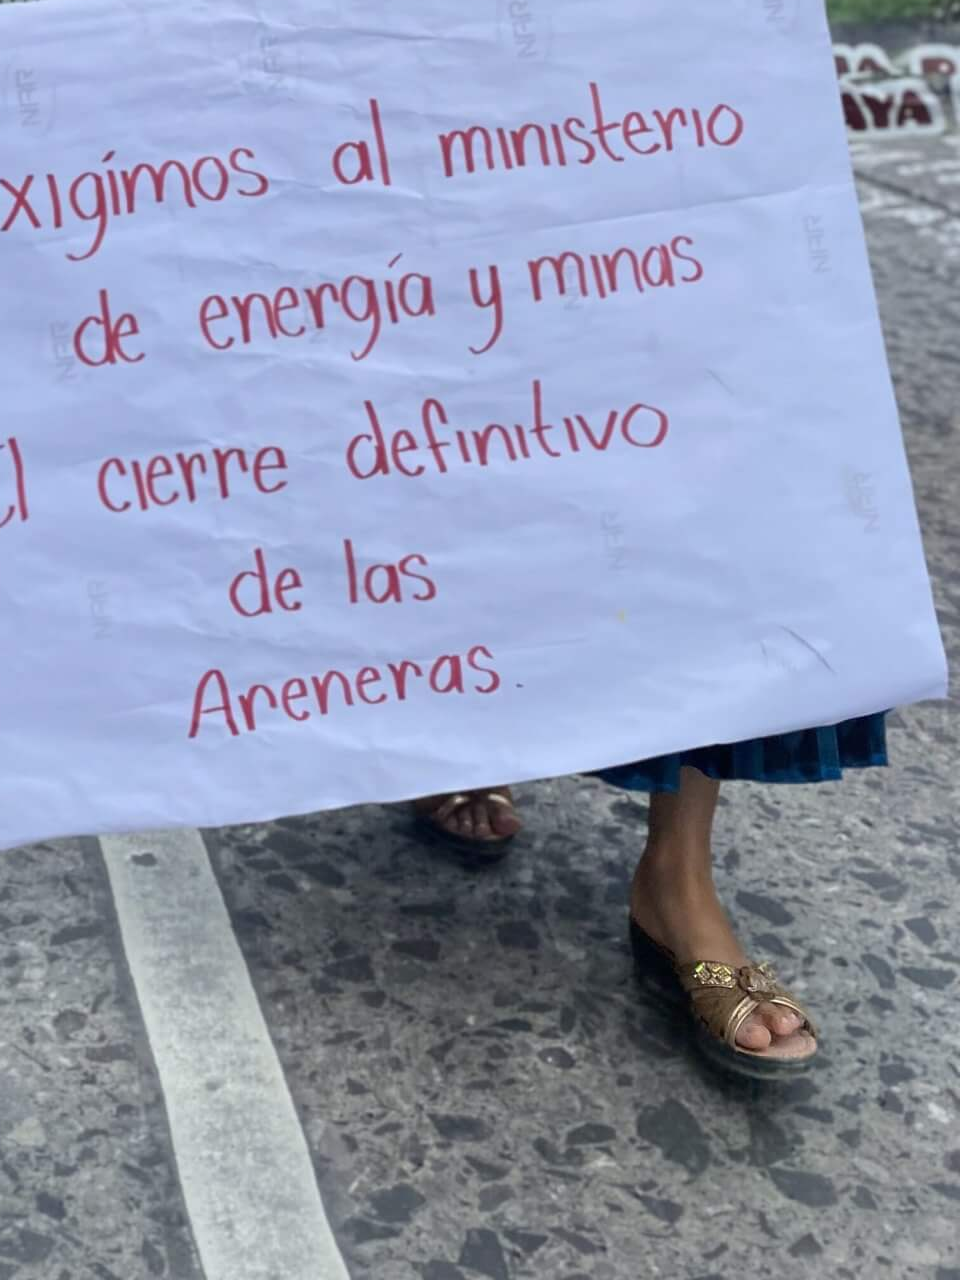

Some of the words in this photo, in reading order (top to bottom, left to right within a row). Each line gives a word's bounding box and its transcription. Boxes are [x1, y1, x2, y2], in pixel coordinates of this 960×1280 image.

[331, 97, 392, 187] al
[438, 81, 744, 178] ministerio
[73, 288, 146, 367] de
[199, 252, 436, 361] energía
[468, 264, 504, 355] y
[527, 235, 704, 302] minas
[97, 444, 289, 513] cierre
[345, 379, 669, 480] definitivo
[228, 547, 303, 617] de
[343, 538, 437, 604] las
